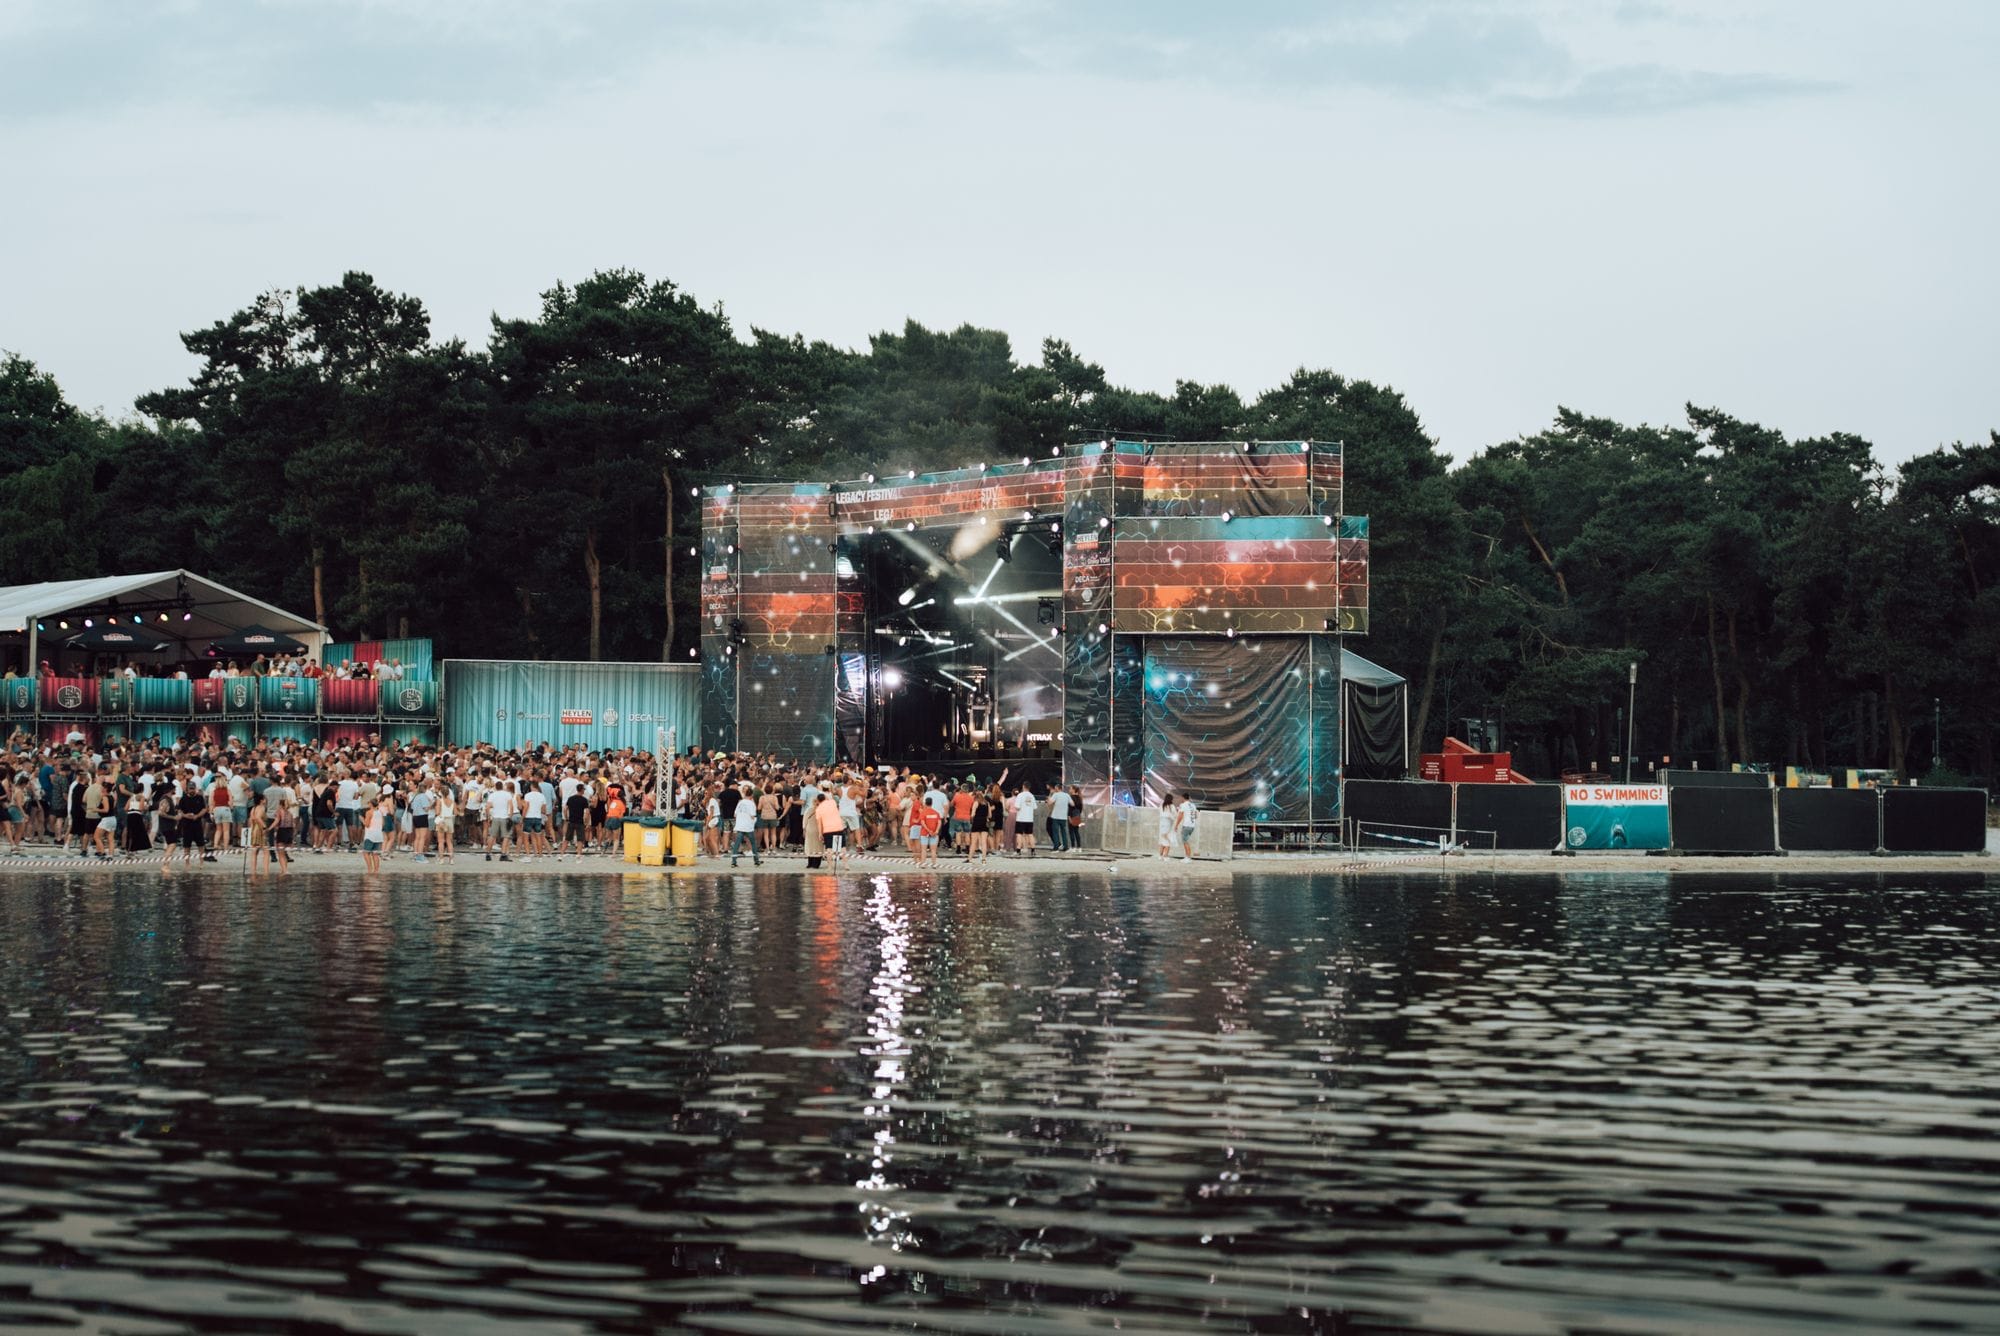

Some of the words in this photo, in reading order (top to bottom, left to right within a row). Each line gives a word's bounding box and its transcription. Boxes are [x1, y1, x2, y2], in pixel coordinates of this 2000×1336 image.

[836, 490, 866, 504] LEGACY
[867, 488, 902, 502] FESTIVAL
[874, 508, 907, 521] LEGACY
[629, 713, 652, 721] DECA
[1570, 789, 1588, 800] NO
[1594, 788, 1662, 800] SWIMMING!
